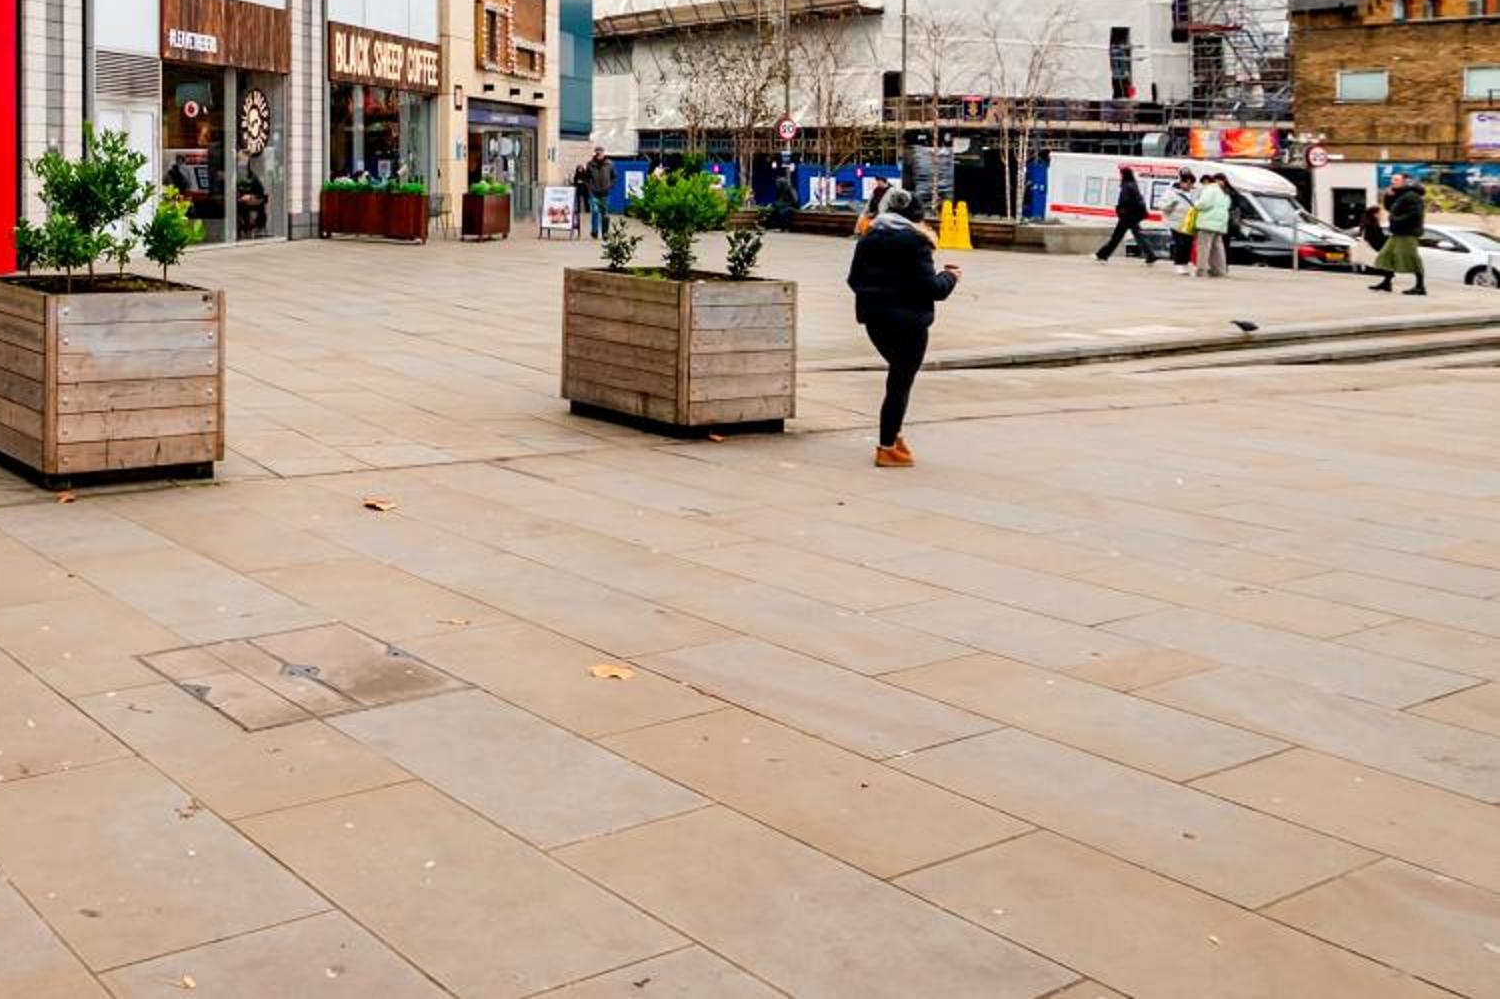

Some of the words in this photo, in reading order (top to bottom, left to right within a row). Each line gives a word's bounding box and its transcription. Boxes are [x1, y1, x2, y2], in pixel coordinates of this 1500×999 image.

[334, 31, 371, 77] BLACK
[373, 39, 404, 82] SHEEP
[407, 46, 439, 87] COFFEE
